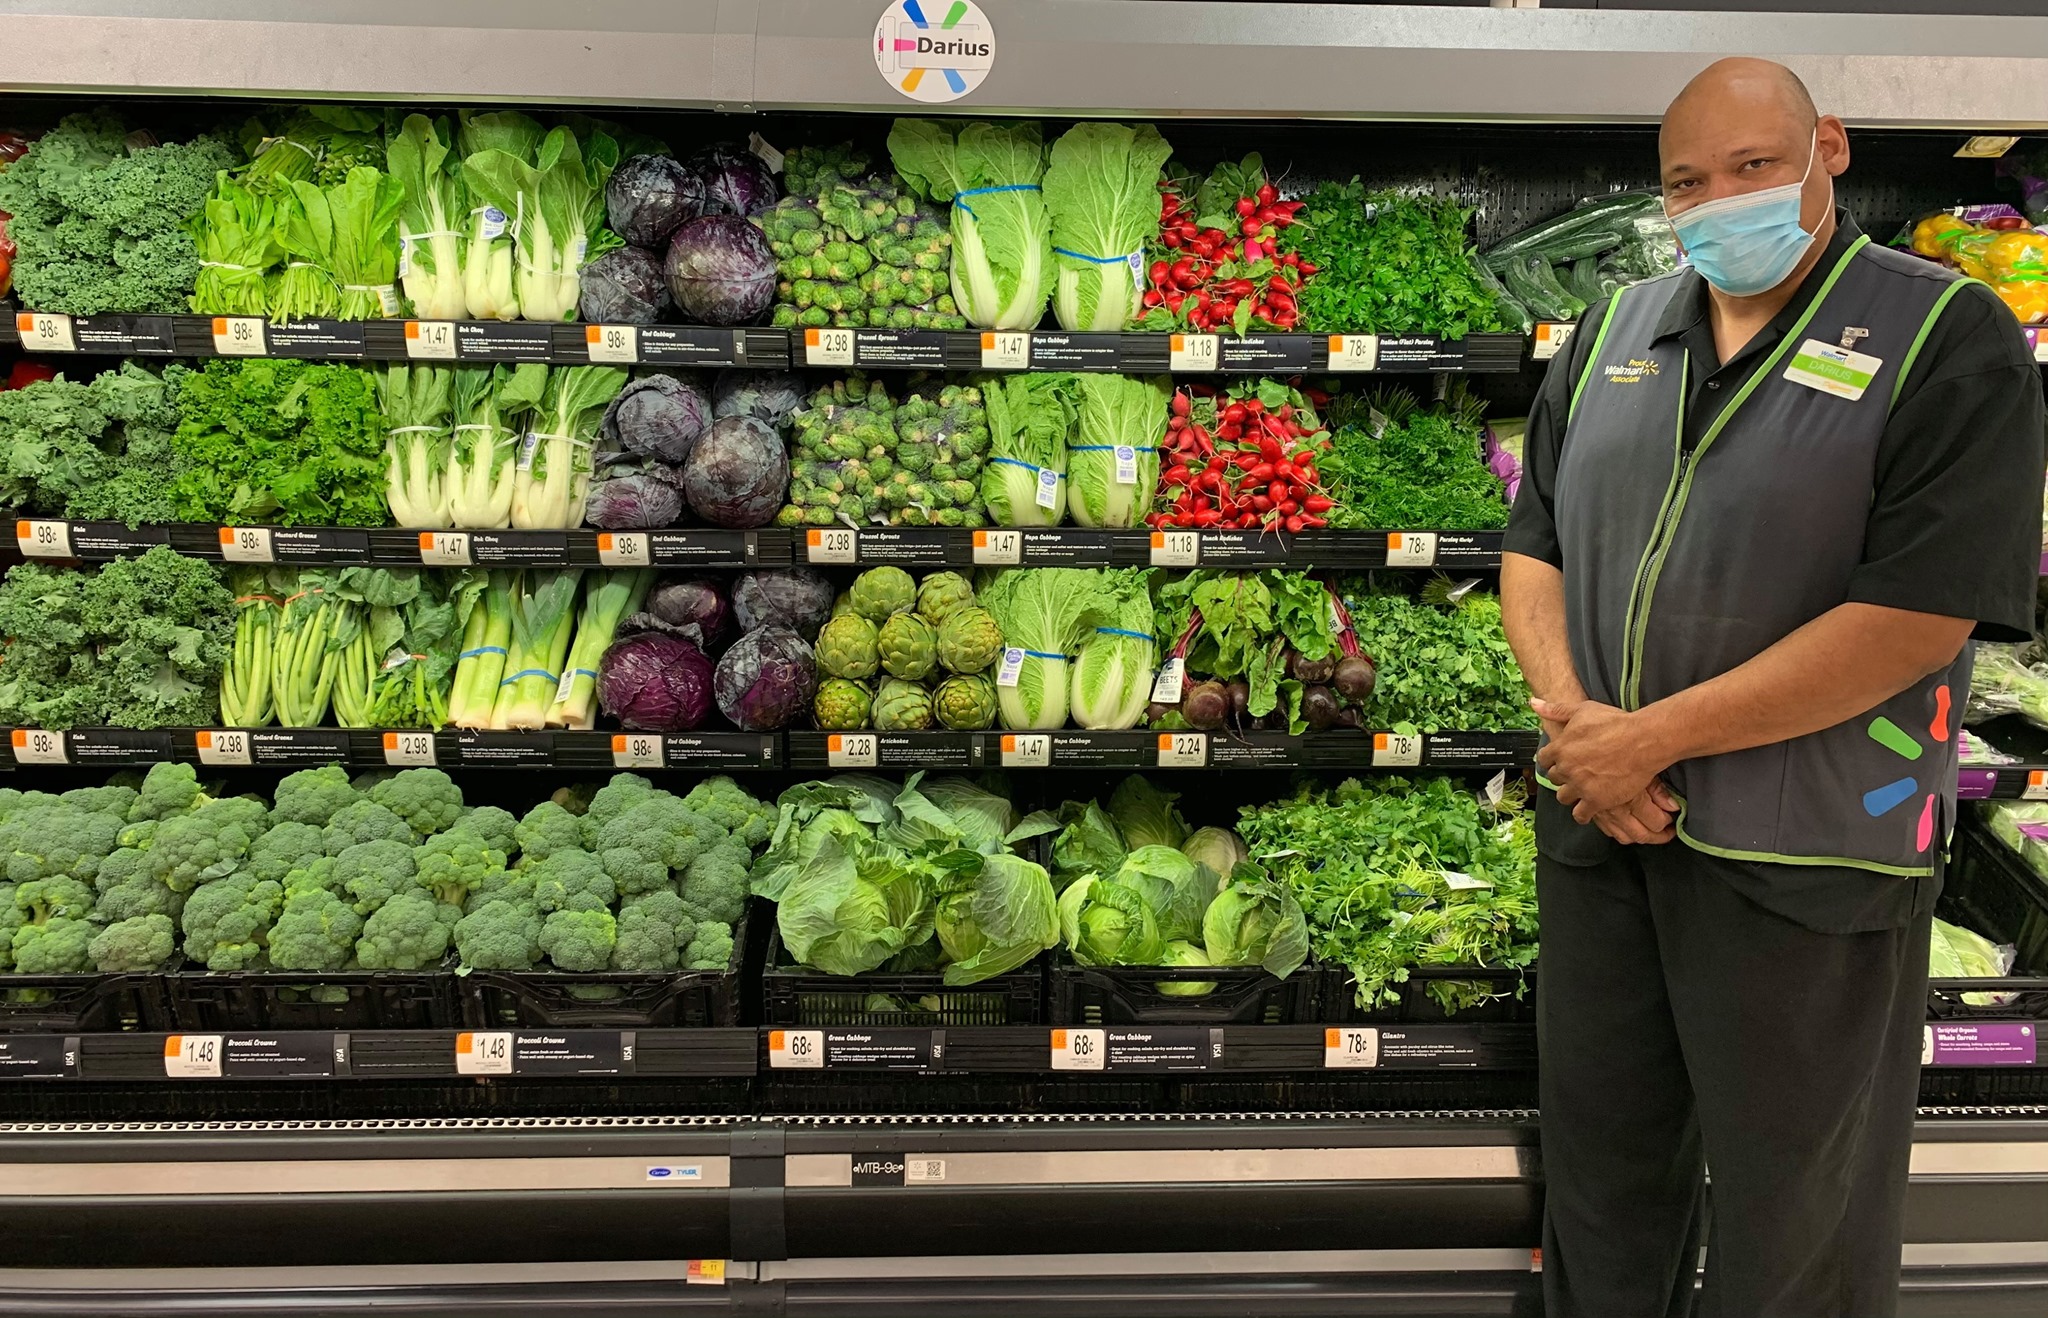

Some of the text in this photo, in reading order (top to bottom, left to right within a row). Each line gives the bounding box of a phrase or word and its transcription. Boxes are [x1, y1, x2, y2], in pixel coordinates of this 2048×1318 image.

[918, 37, 989, 56] Darius
[653, 330, 676, 339] Cabbage
[736, 342, 744, 354] USA
[1820, 351, 1847, 362] Walmart
[1604, 365, 1644, 375] Walmart
[1809, 361, 1853, 380] DARIUS
[1160, 675, 1178, 684] BEETS
[678, 738, 702, 746] Cabbage
[1937, 1027, 1978, 1035] Certified Organic
[542, 1036, 566, 1044] Crowns
[846, 1034, 871, 1043] Cabbage
[1127, 1033, 1152, 1042] Cabbage
[336, 1048, 344, 1062] USA
[624, 1046, 633, 1061] USA
[933, 1045, 942, 1058] USA
[1213, 1043, 1222, 1058] USA
[65, 1051, 74, 1066] USA
[677, 1169, 698, 1177] TYLER
